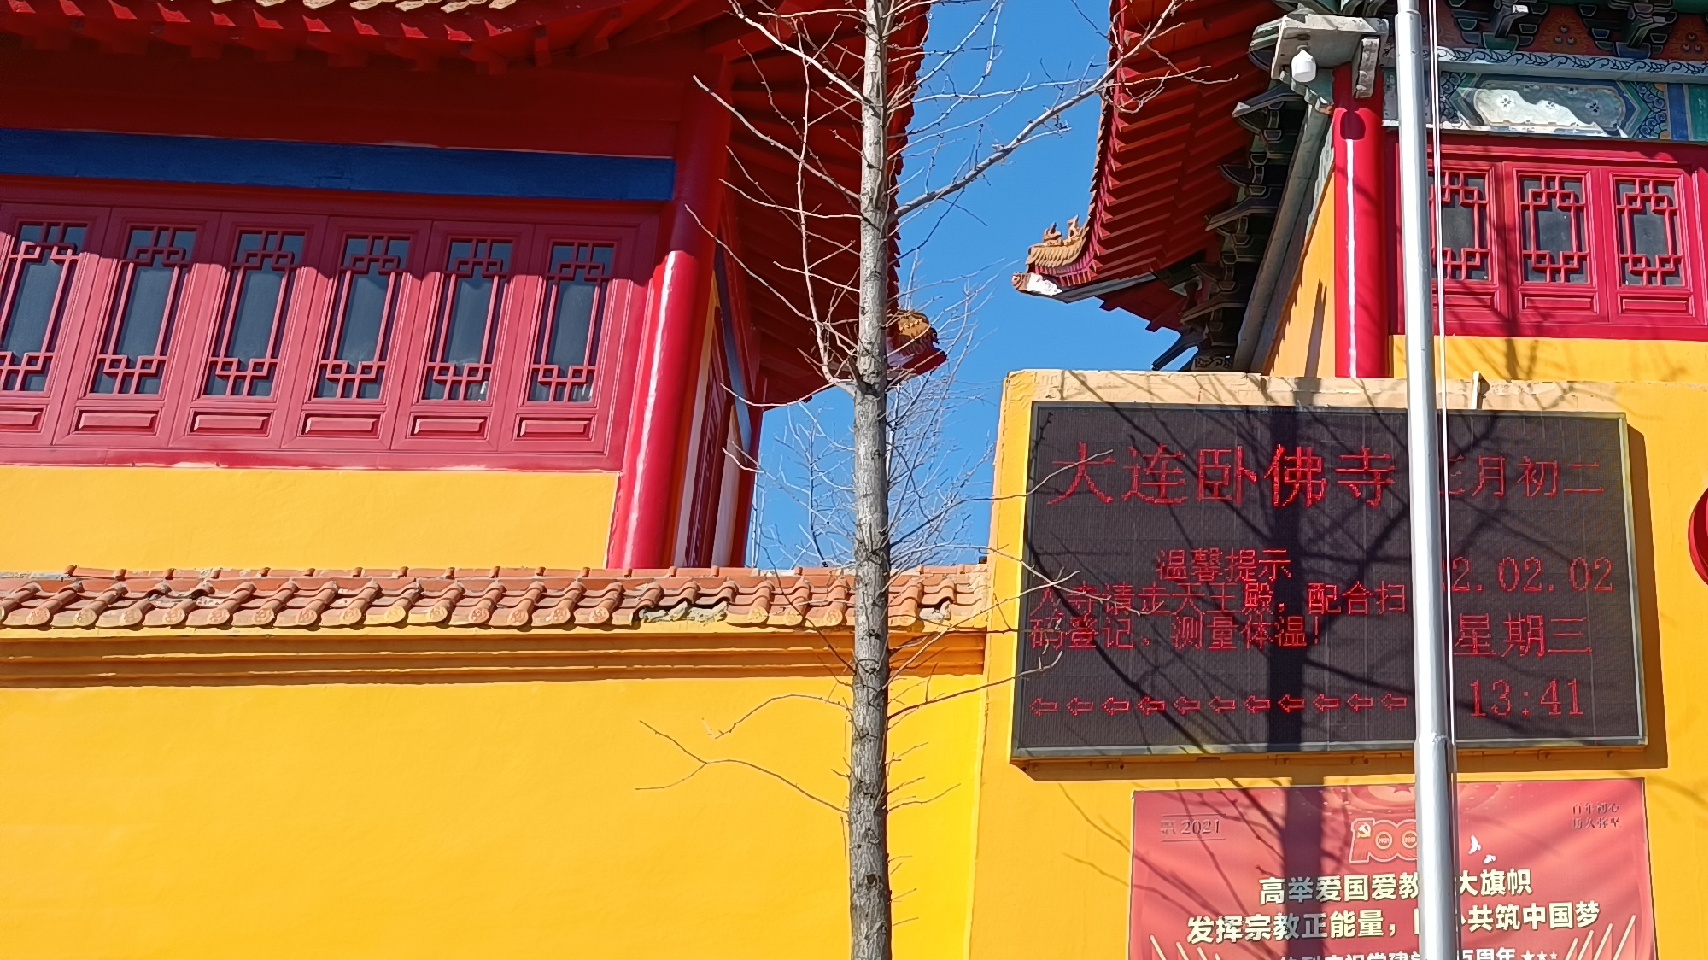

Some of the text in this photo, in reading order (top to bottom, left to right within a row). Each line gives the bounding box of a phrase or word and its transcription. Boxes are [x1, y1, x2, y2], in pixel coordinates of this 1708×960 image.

[1046, 442, 1396, 508] 大连卧佛寺
[1156, 547, 1293, 582] 温馨提示
[1442, 556, 1616, 593] 2.02.02
[1453, 612, 1593, 658] 星期三
[1470, 678, 1585, 717] 13:41
[1180, 819, 1220, 835] 2021
[1258, 868, 1532, 905] 高举爱国爱教大旗帜
[1187, 900, 1601, 944] 发挥宗教正能量，共筑中国梦
